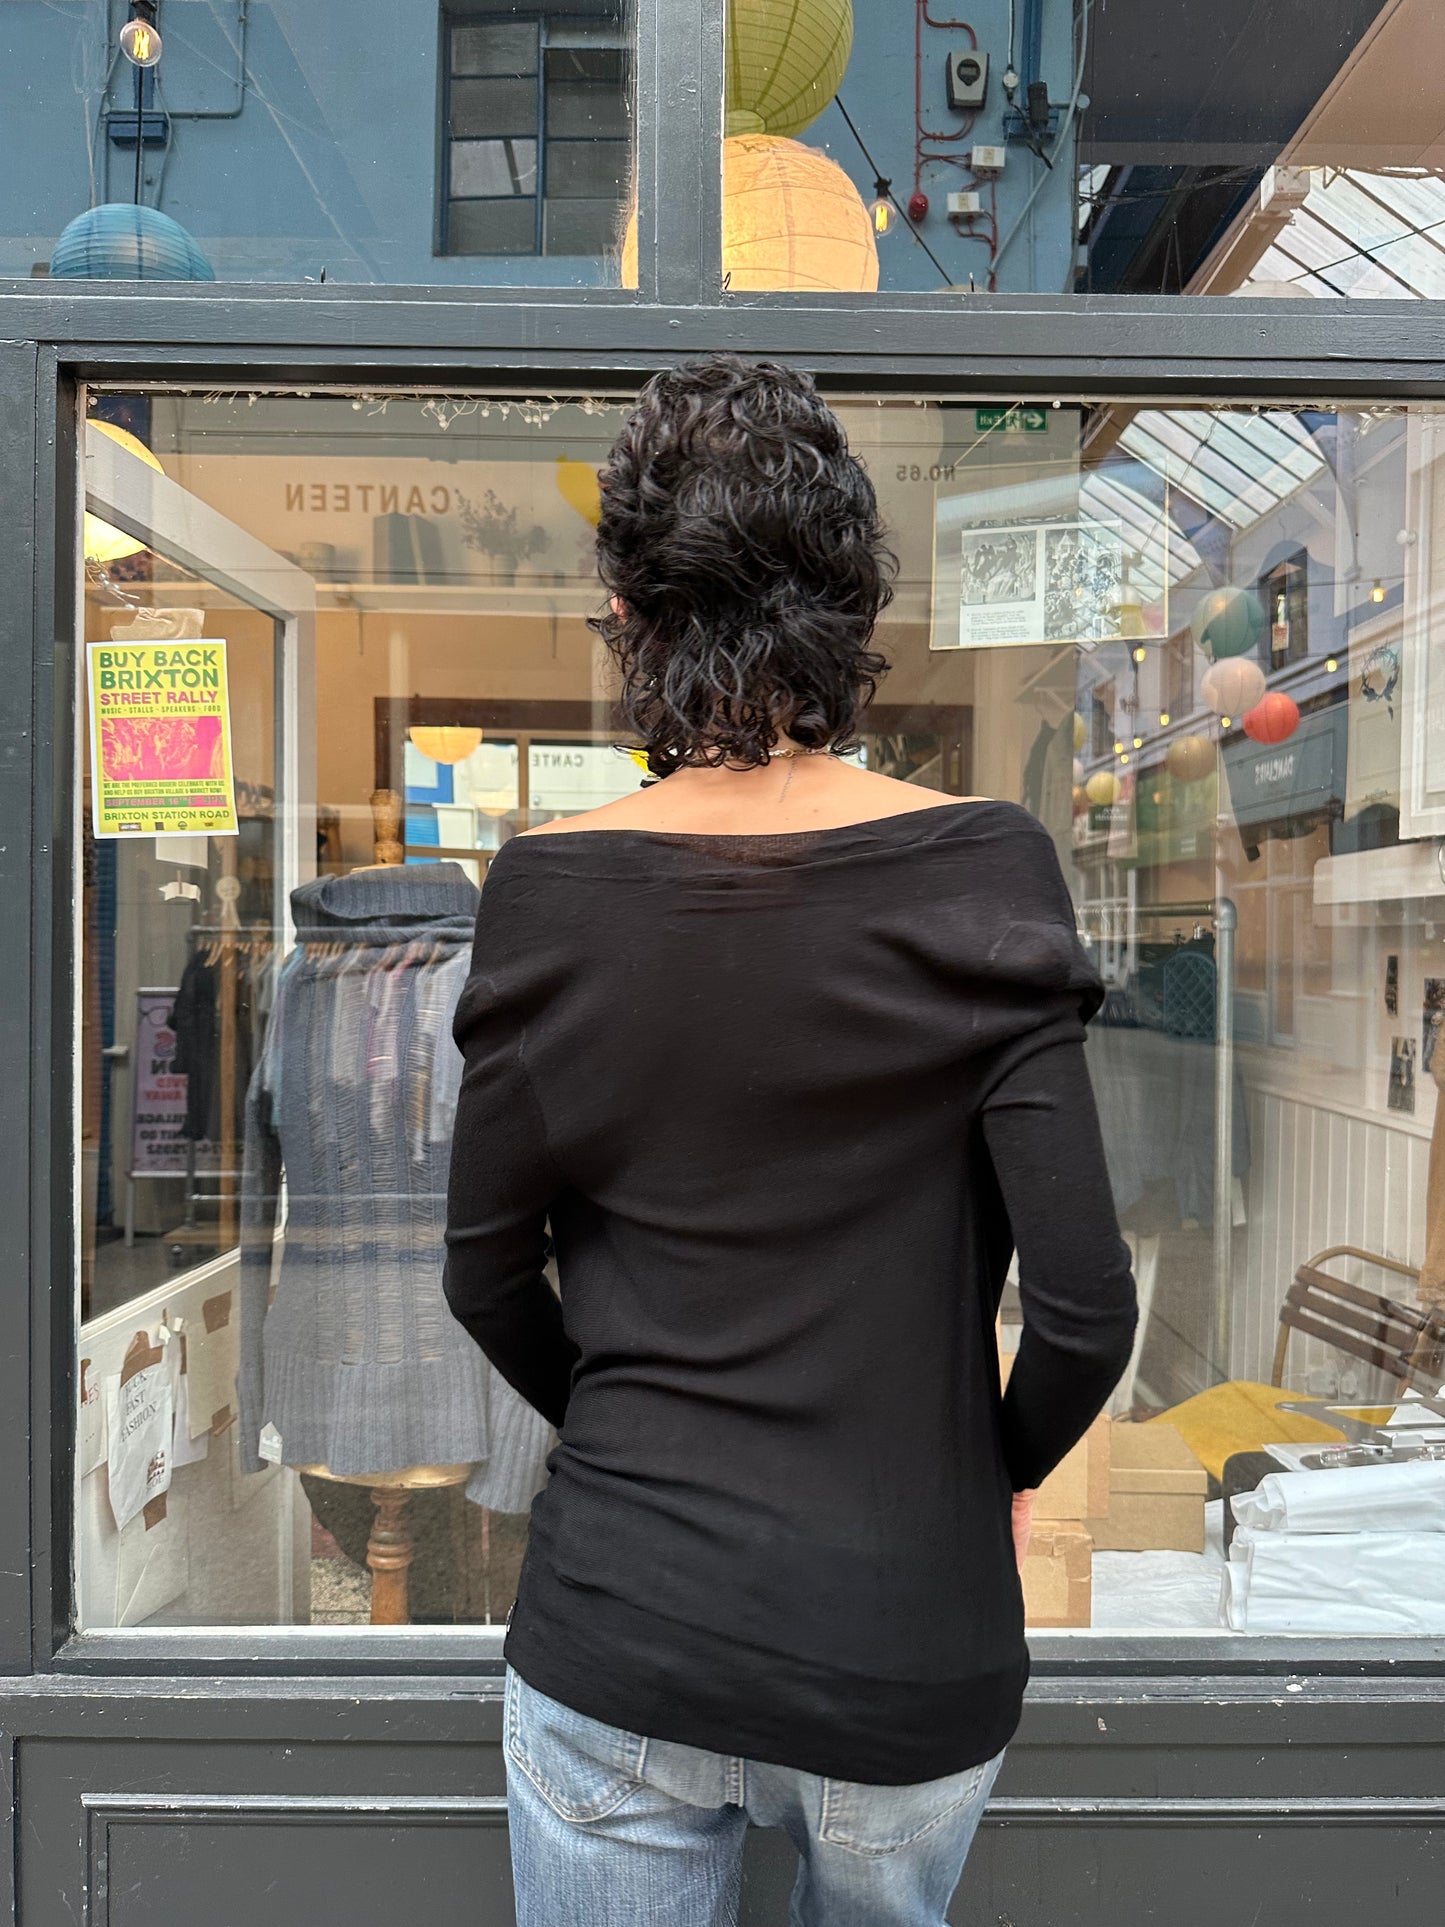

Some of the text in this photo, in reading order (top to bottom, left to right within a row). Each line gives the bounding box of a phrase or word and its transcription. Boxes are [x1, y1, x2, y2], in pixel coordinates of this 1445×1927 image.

[100, 649, 217, 668] BUY BACK
[100, 667, 219, 690] BRIXTON
[100, 690, 218, 706] STREET RALLY
[101, 704, 221, 715] MUSIC STALLS SPEAKERS FOOD
[114, 788, 126, 796] HELP
[105, 798, 165, 807] SEPTEMBER
[104, 809, 230, 820] BRIXTON STATION ROAD
[125, 1389, 146, 1416] FAST
[120, 1401, 158, 1443] FASHION
